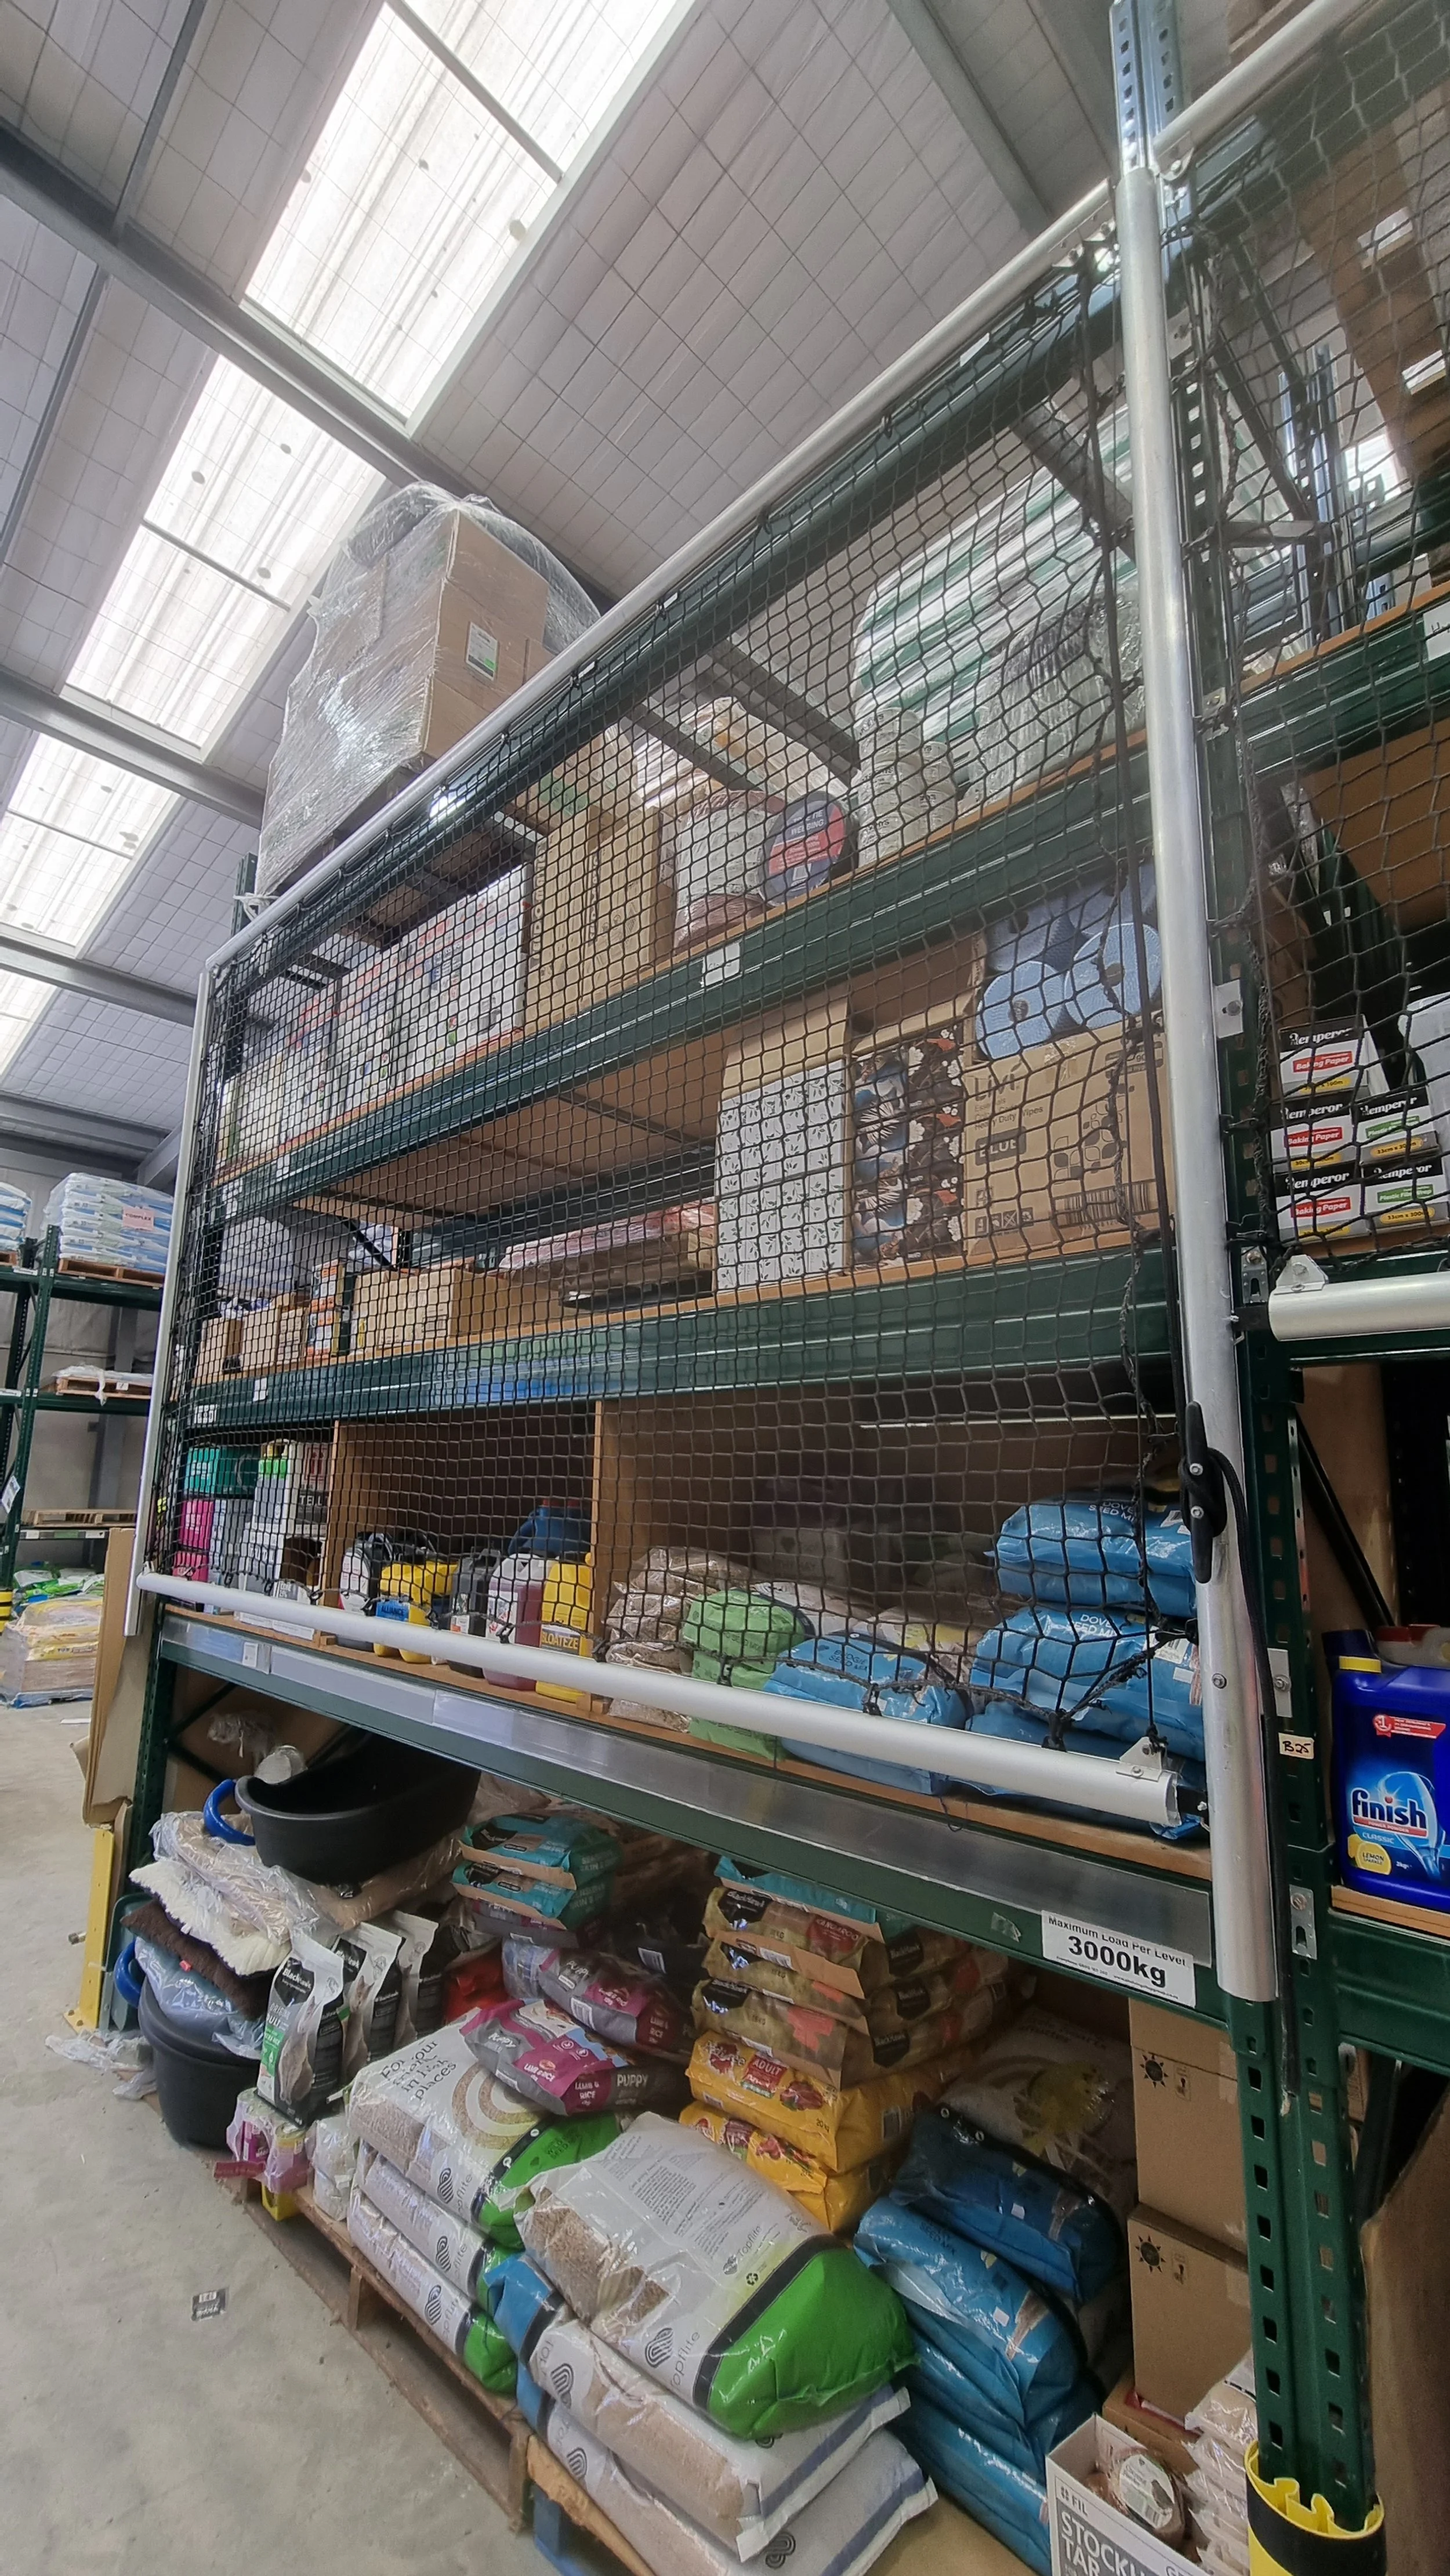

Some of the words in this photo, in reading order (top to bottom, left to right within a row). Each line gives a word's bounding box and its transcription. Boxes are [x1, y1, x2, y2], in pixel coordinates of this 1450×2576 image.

[1296, 1060, 1324, 1070] Bakng
[1325, 1056, 1350, 1066] Paper
[975, 1120, 996, 1131] Heay
[999, 1114, 1016, 1124] Duty
[1315, 1132, 1340, 1141] Paper
[1322, 1202, 1348, 1212] Paper
[828, 1656, 853, 1667] SED
[833, 1649, 867, 1665] BDGIE
[1282, 1741, 1311, 1754] B25
[1351, 1788, 1427, 1829] finish
[1362, 1832, 1395, 1844] CLASSIC
[1362, 1852, 1384, 1862] LEMON
[1048, 1916, 1099, 1939] Maximum
[1101, 1934, 1129, 1948] Load
[1132, 1944, 1151, 1955] Per
[1155, 1950, 1186, 1966] Level
[1068, 1935, 1166, 1988] 3000kg
[411, 2041, 438, 2060] our
[753, 2059, 782, 2076] ADULT
[401, 2079, 419, 2093] in
[415, 2063, 456, 2101] places
[617, 2074, 649, 2088] PUPPY
[579, 2090, 596, 2100] RICE
[1072, 2495, 1089, 2517] FIL
[1061, 2531, 1101, 2576] TAR
